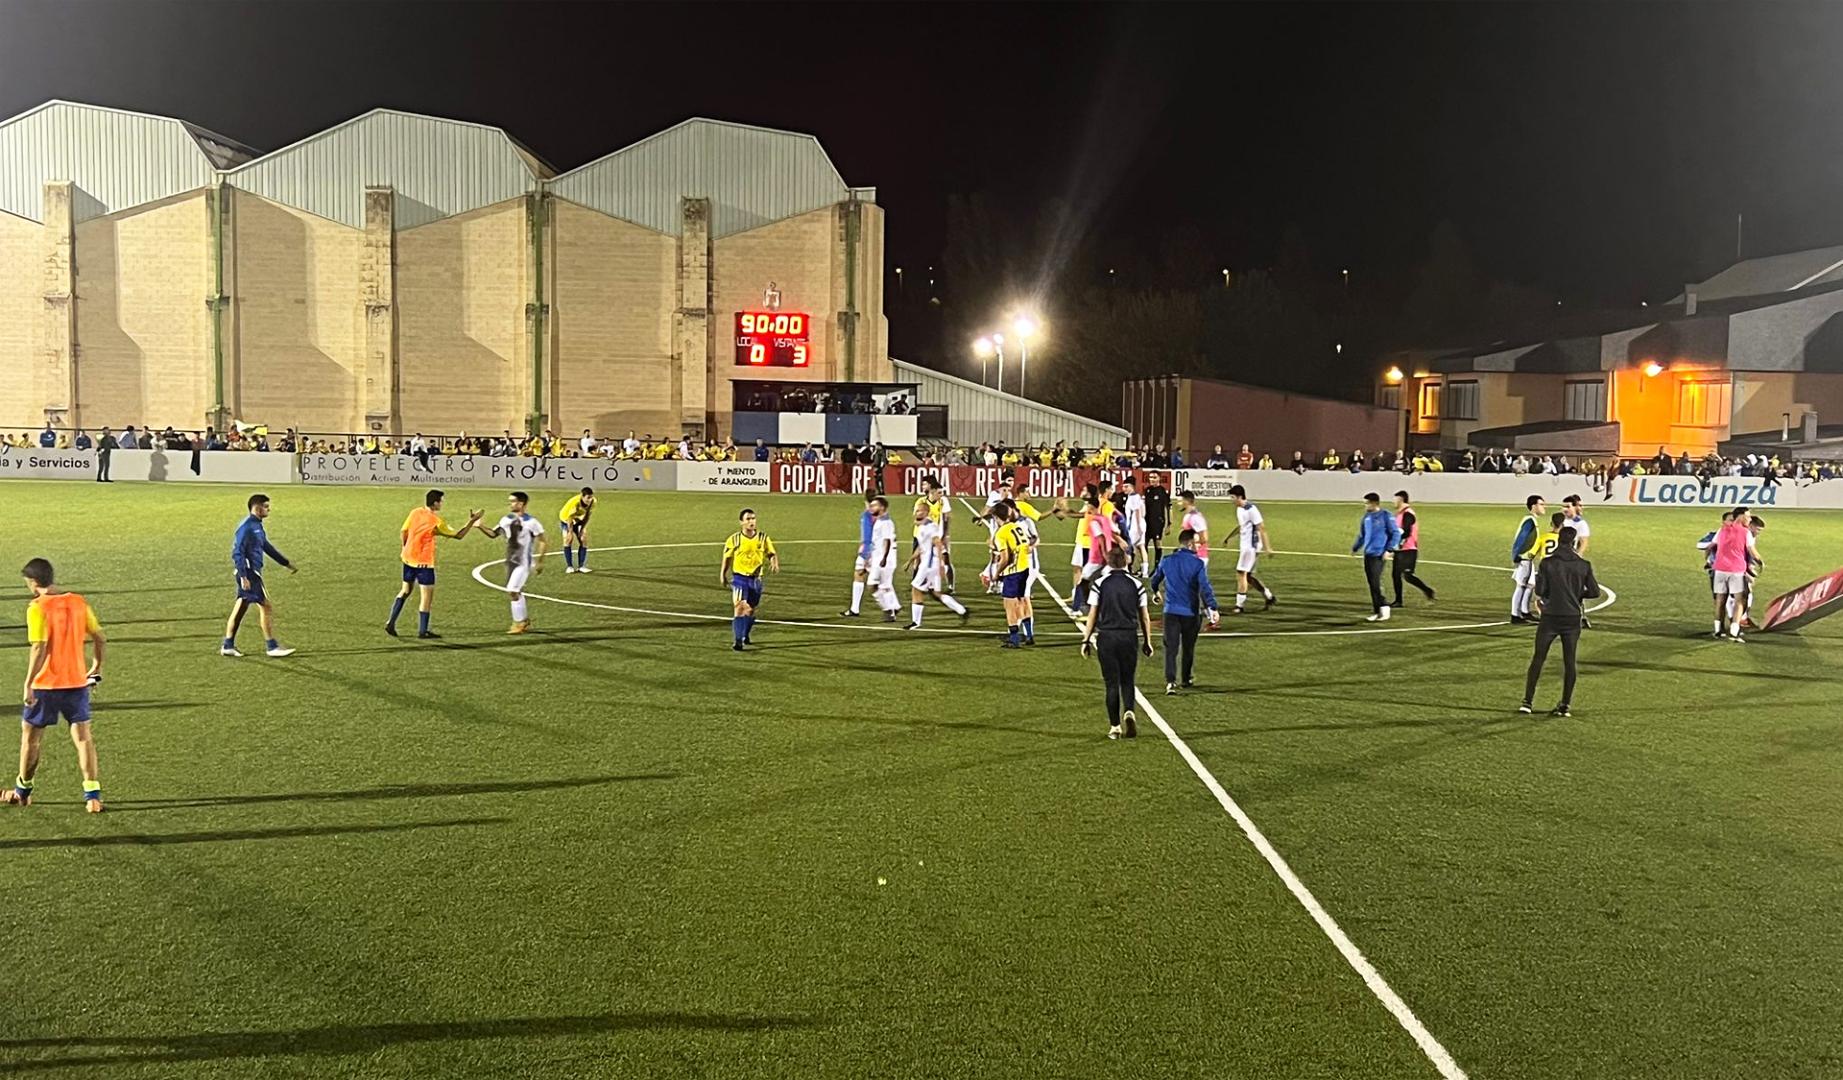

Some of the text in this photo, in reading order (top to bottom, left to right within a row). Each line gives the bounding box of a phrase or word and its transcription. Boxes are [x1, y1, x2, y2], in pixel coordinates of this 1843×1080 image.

[750, 344, 806, 364] 0 3
[16, 459, 23, 469] y
[29, 457, 90, 468] Servicios
[304, 456, 474, 472] PROYELECTRO
[410, 474, 475, 483] Multisectorial
[721, 478, 767, 486] ARANGUREN
[781, 464, 826, 494] COPA
[852, 465, 874, 494] RE
[1029, 468, 1075, 497] COPA
